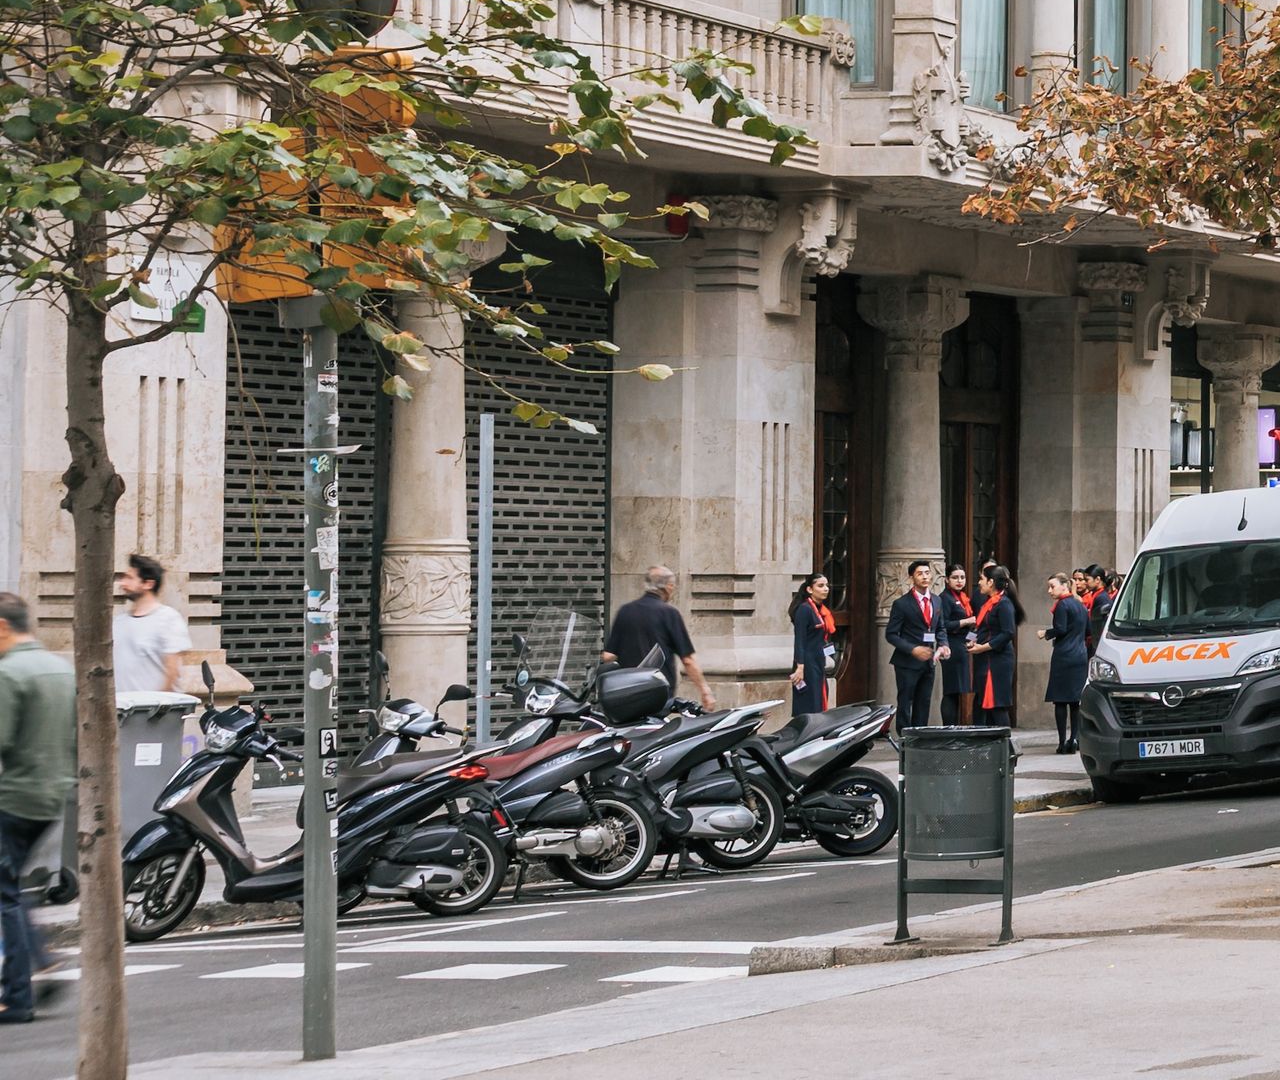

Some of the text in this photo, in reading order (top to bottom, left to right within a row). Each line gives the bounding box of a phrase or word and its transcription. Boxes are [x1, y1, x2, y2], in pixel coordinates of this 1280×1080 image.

[1128, 641, 1238, 666] NACEX
[1147, 741, 1201, 755] 7671 MDR
